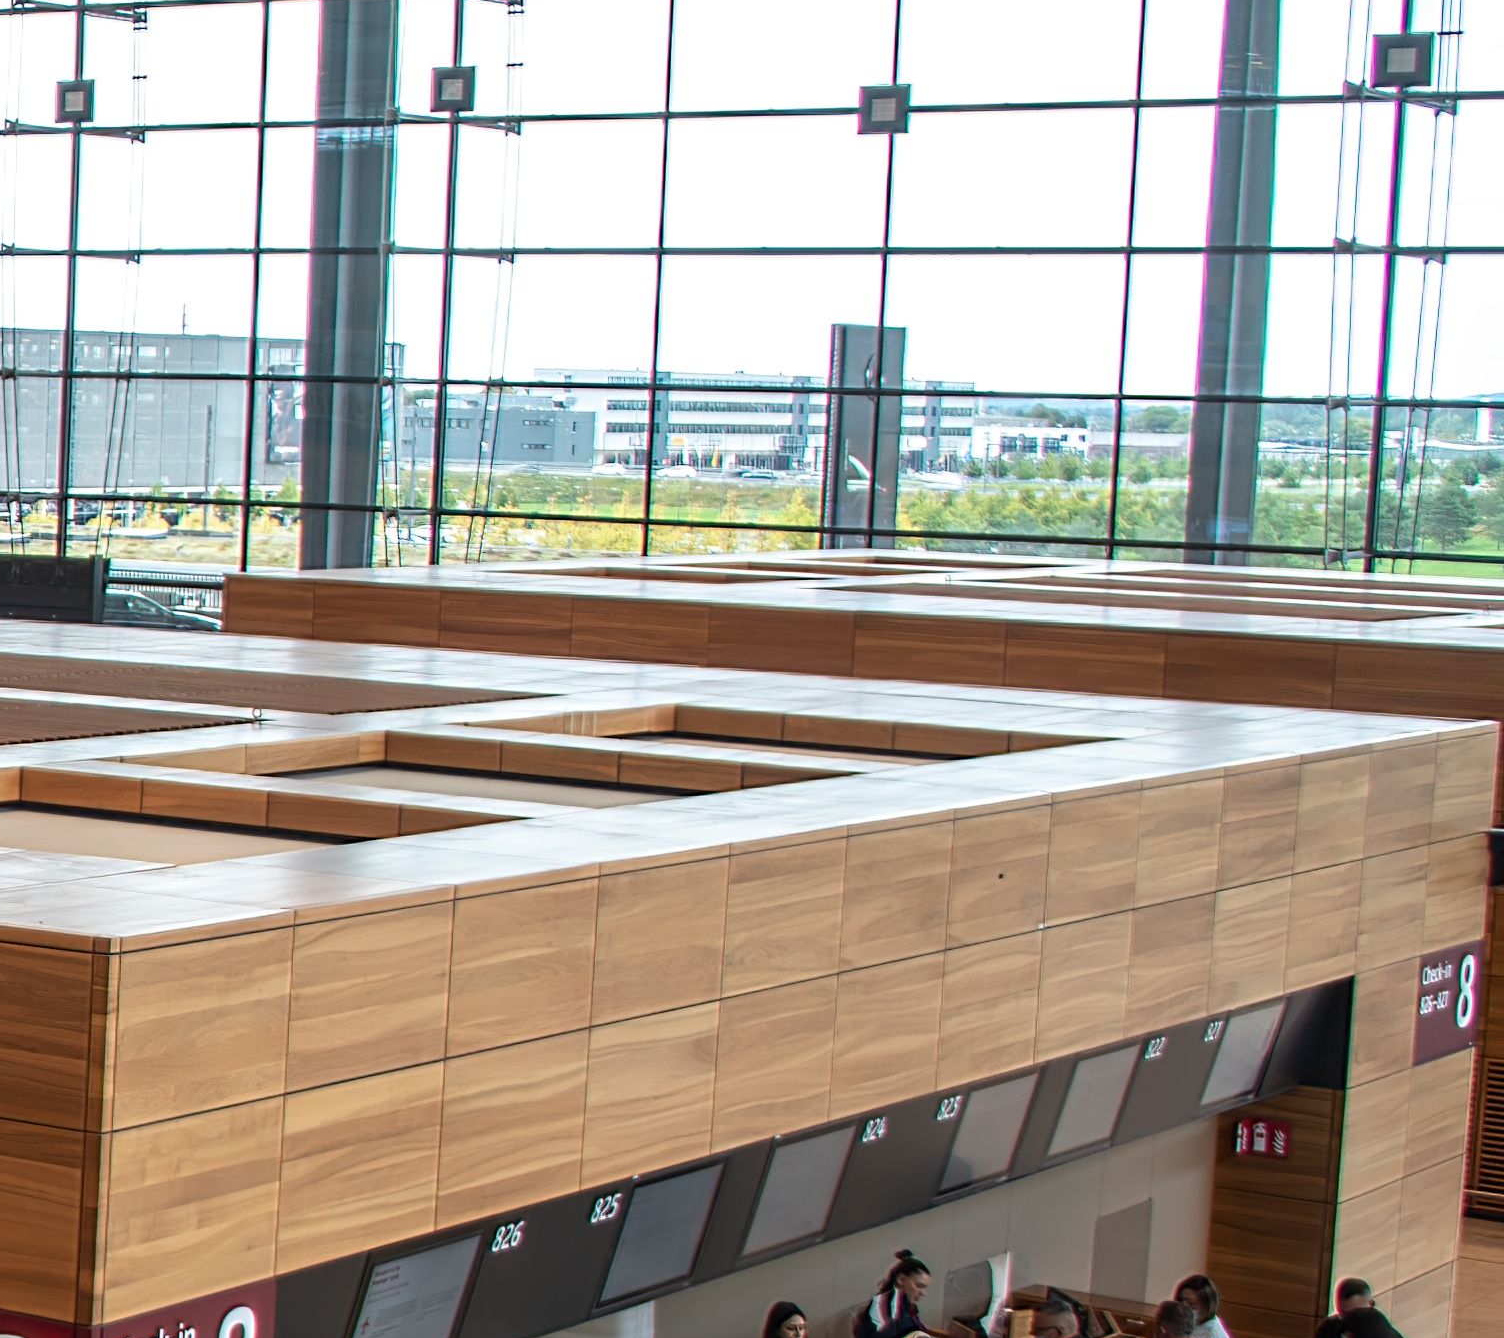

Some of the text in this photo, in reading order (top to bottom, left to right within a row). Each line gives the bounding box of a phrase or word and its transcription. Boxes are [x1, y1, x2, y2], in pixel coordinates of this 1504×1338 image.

[1422, 960, 1452, 986] Check-in
[1456, 954, 1475, 1028] 8
[1144, 1036, 1167, 1061] 822
[936, 1095, 963, 1121] 823
[861, 1116, 888, 1144] 824
[590, 1193, 623, 1224] 825
[491, 1220, 527, 1253] 826
